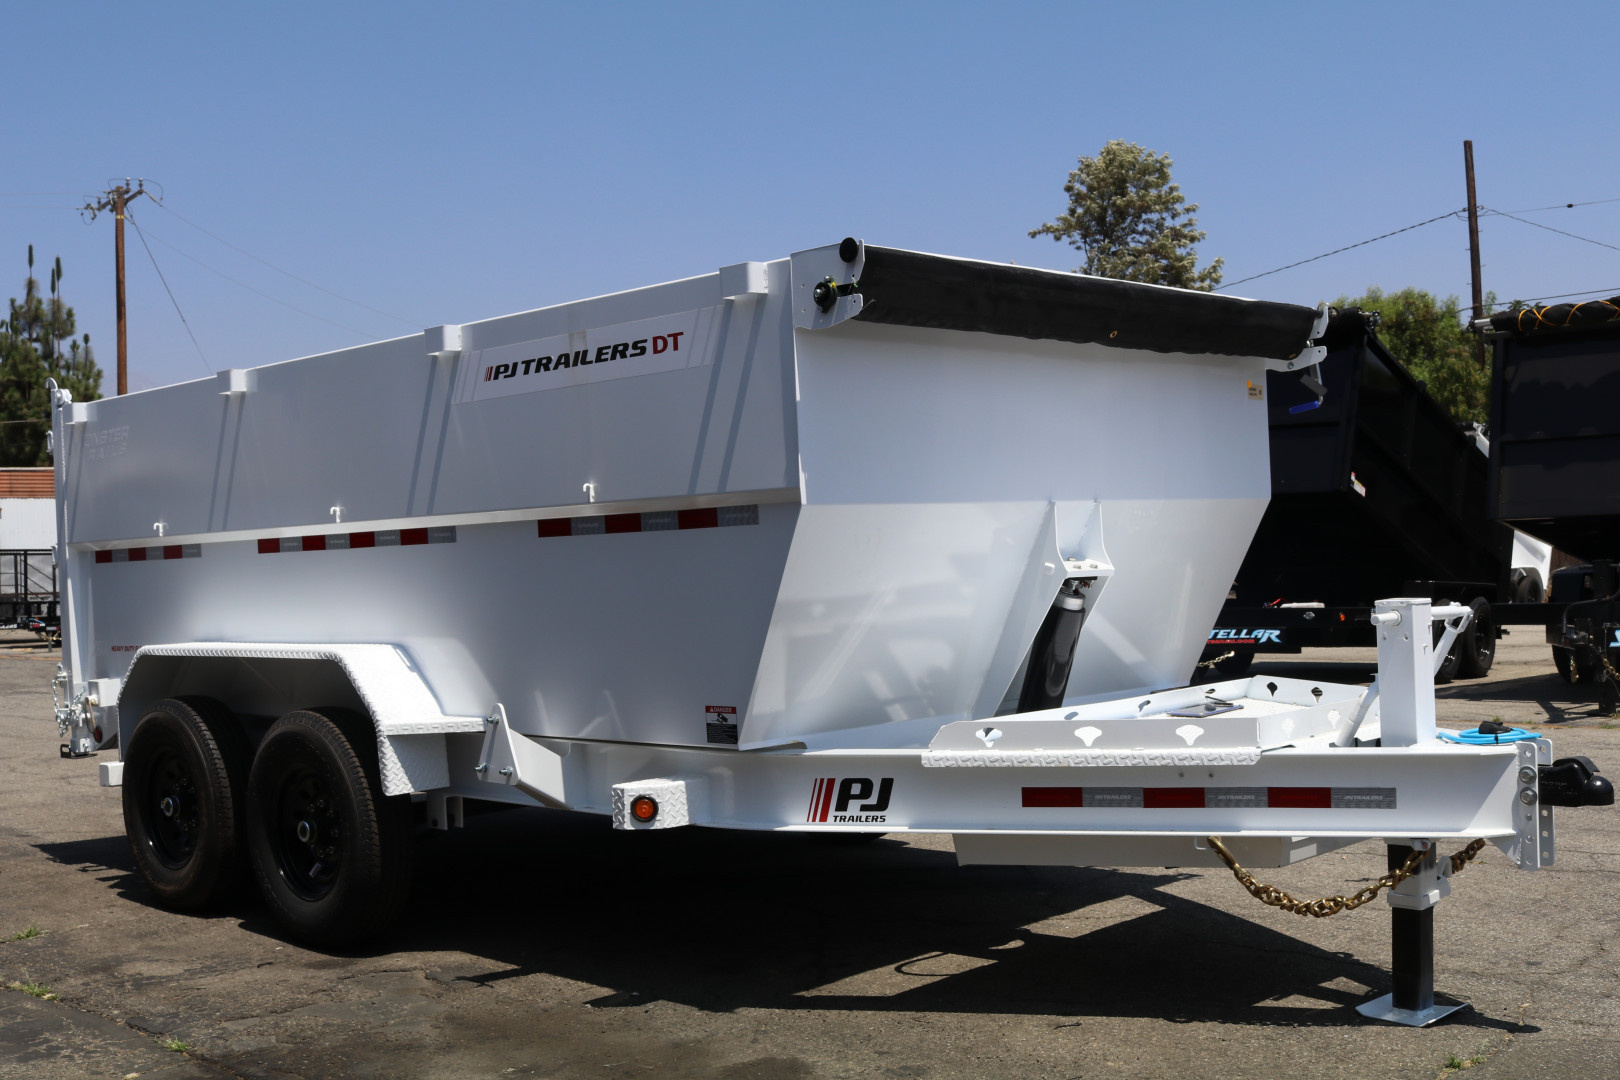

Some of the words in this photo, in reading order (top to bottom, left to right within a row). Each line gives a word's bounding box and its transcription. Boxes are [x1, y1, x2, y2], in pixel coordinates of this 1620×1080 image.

[652, 331, 684, 355] DT
[1208, 628, 1283, 644] TELLAR
[834, 777, 895, 812] PJ
[832, 815, 887, 823] TRAILERS
